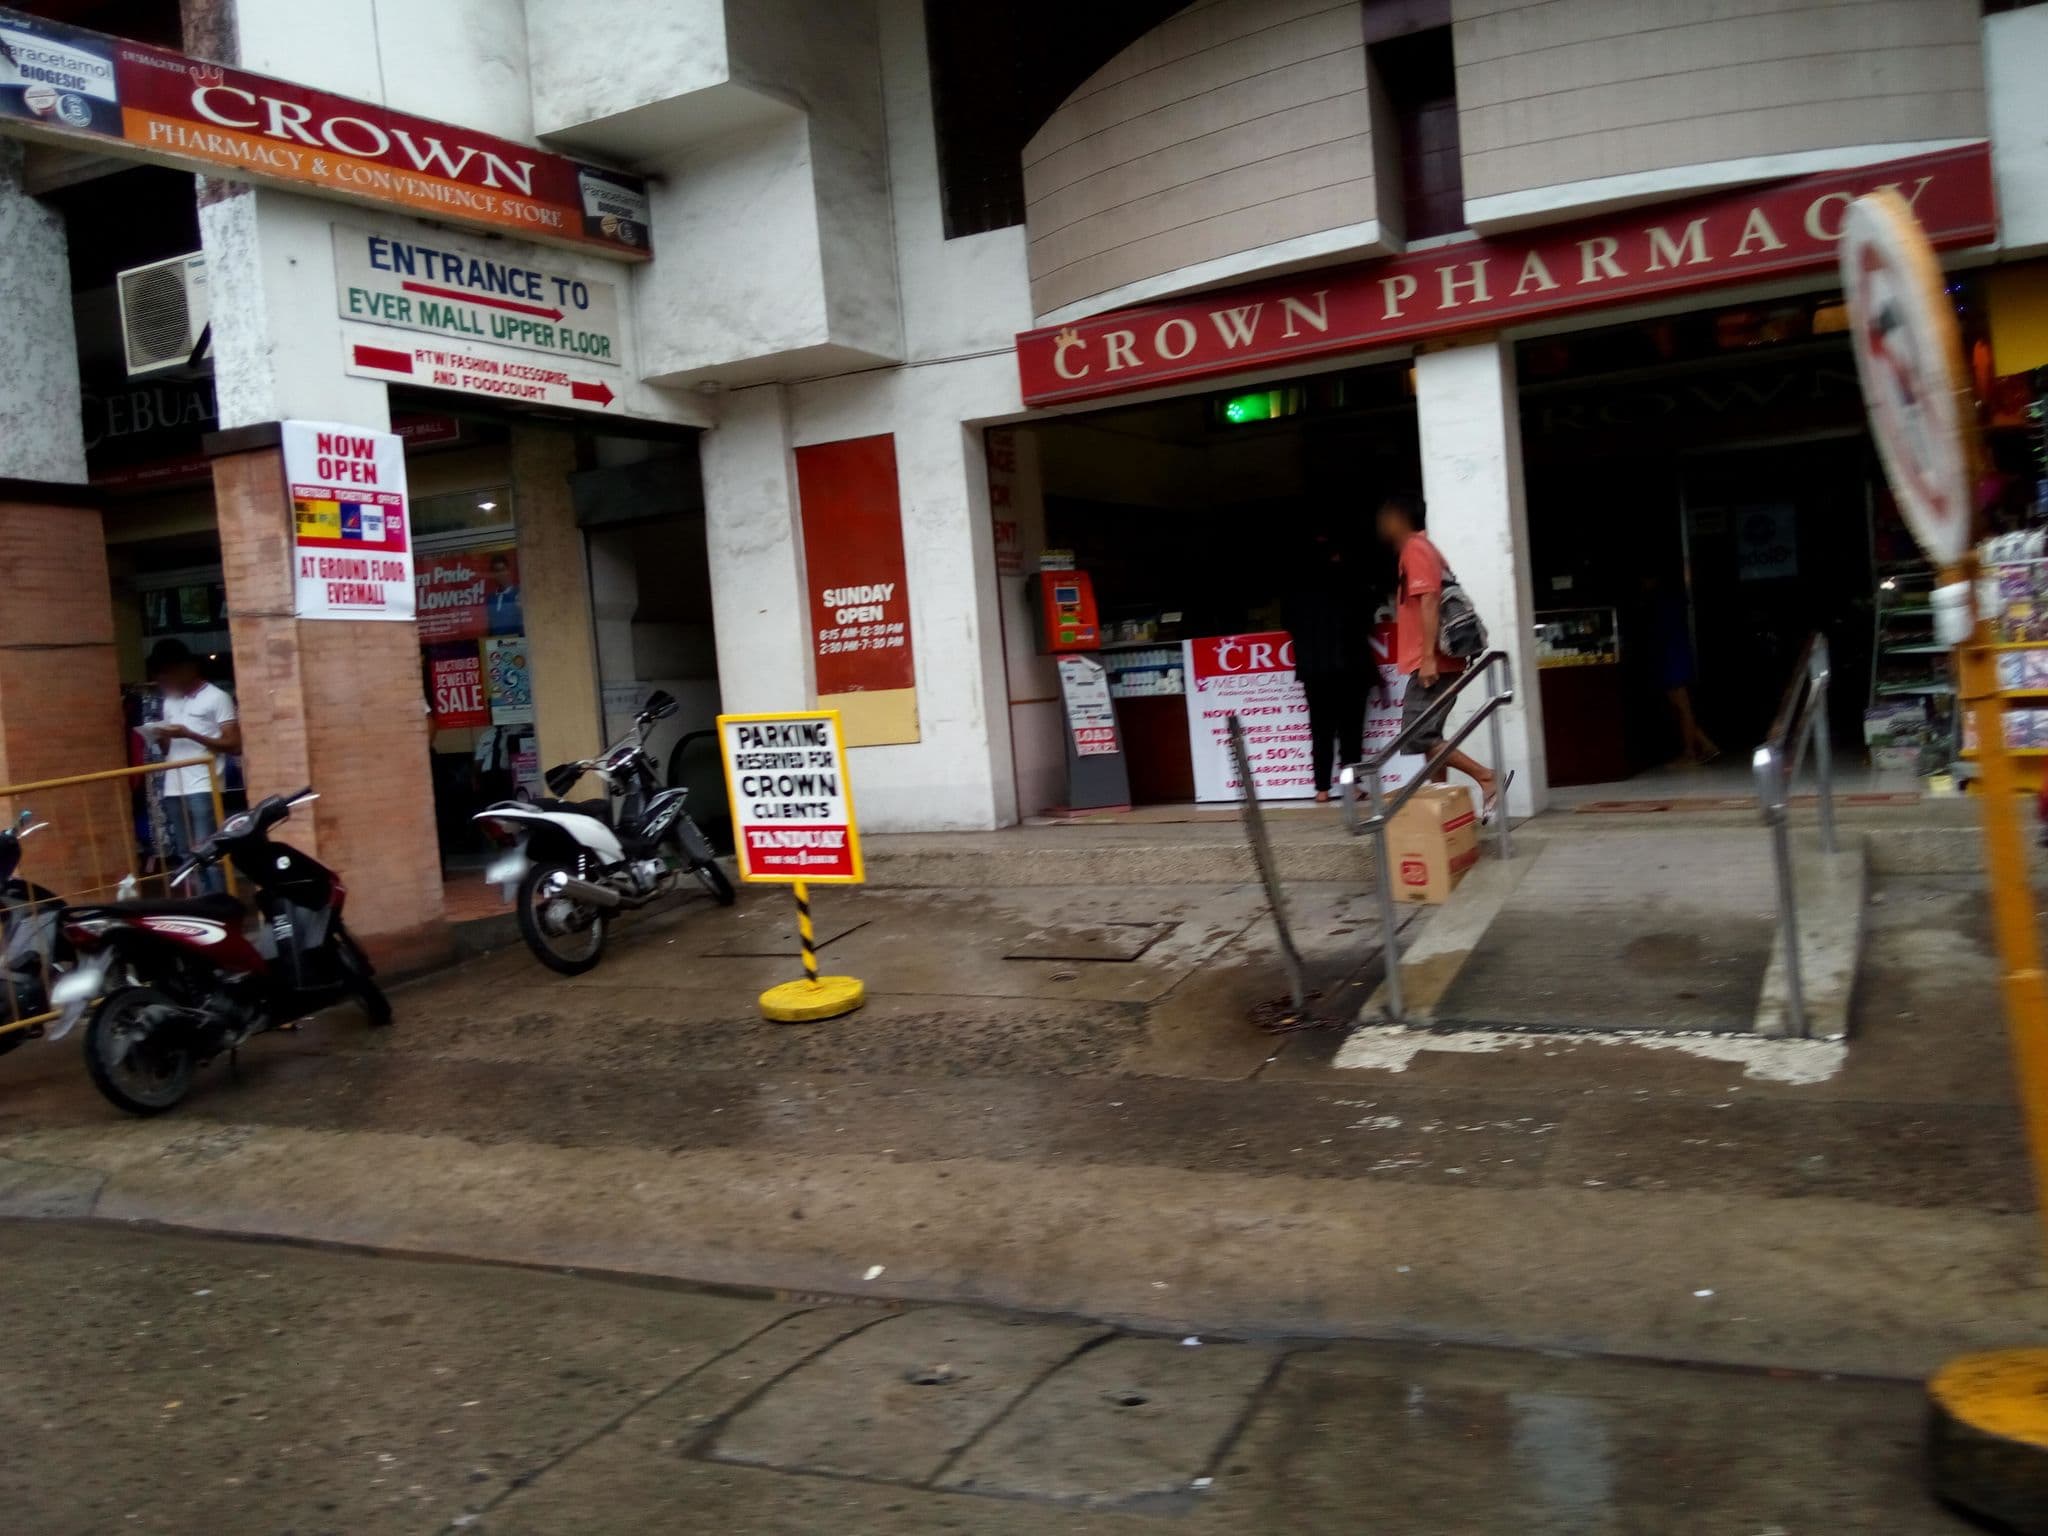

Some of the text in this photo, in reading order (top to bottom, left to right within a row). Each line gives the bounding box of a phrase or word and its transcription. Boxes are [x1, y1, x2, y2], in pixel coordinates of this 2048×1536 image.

[20, 63, 87, 91] BIOGESIC
[191, 85, 535, 197] CROWN
[149, 121, 563, 229] PHARMACY & CONVENIENCE STORE
[368, 236, 590, 311] ENTRANCE TO
[1054, 176, 1935, 380] CROWN PHARMACY
[349, 288, 612, 359] EVER MALL UPPER FLOOR
[450, 354, 499, 375] FASHION
[502, 363, 571, 387] ACCESSORIES
[433, 370, 547, 400] AND FOODCOURT
[317, 432, 375, 460] NOW
[317, 457, 378, 485] OPEN
[301, 556, 406, 583] AT GROUND FLOOR
[328, 582, 386, 606] EVERMALL
[418, 579, 486, 611] Lowest!
[822, 582, 895, 608] SUNDAY
[835, 604, 884, 625] OPEN
[886, 622, 905, 635] PM
[886, 636, 905, 648] PM
[436, 671, 480, 689] JEWELRY
[1211, 673, 1289, 689] MEDICAL
[437, 685, 484, 715] SALE
[1203, 708, 1237, 718] NOW
[1241, 706, 1282, 716] OPEN
[1287, 704, 1310, 713] TO
[736, 723, 829, 750] PARKING
[735, 751, 834, 771] RESERVED FOR
[1265, 747, 1305, 760] 50%
[741, 773, 839, 798] CROWN
[752, 801, 831, 820] CLIENTS
[747, 830, 847, 849] TANDUAY
